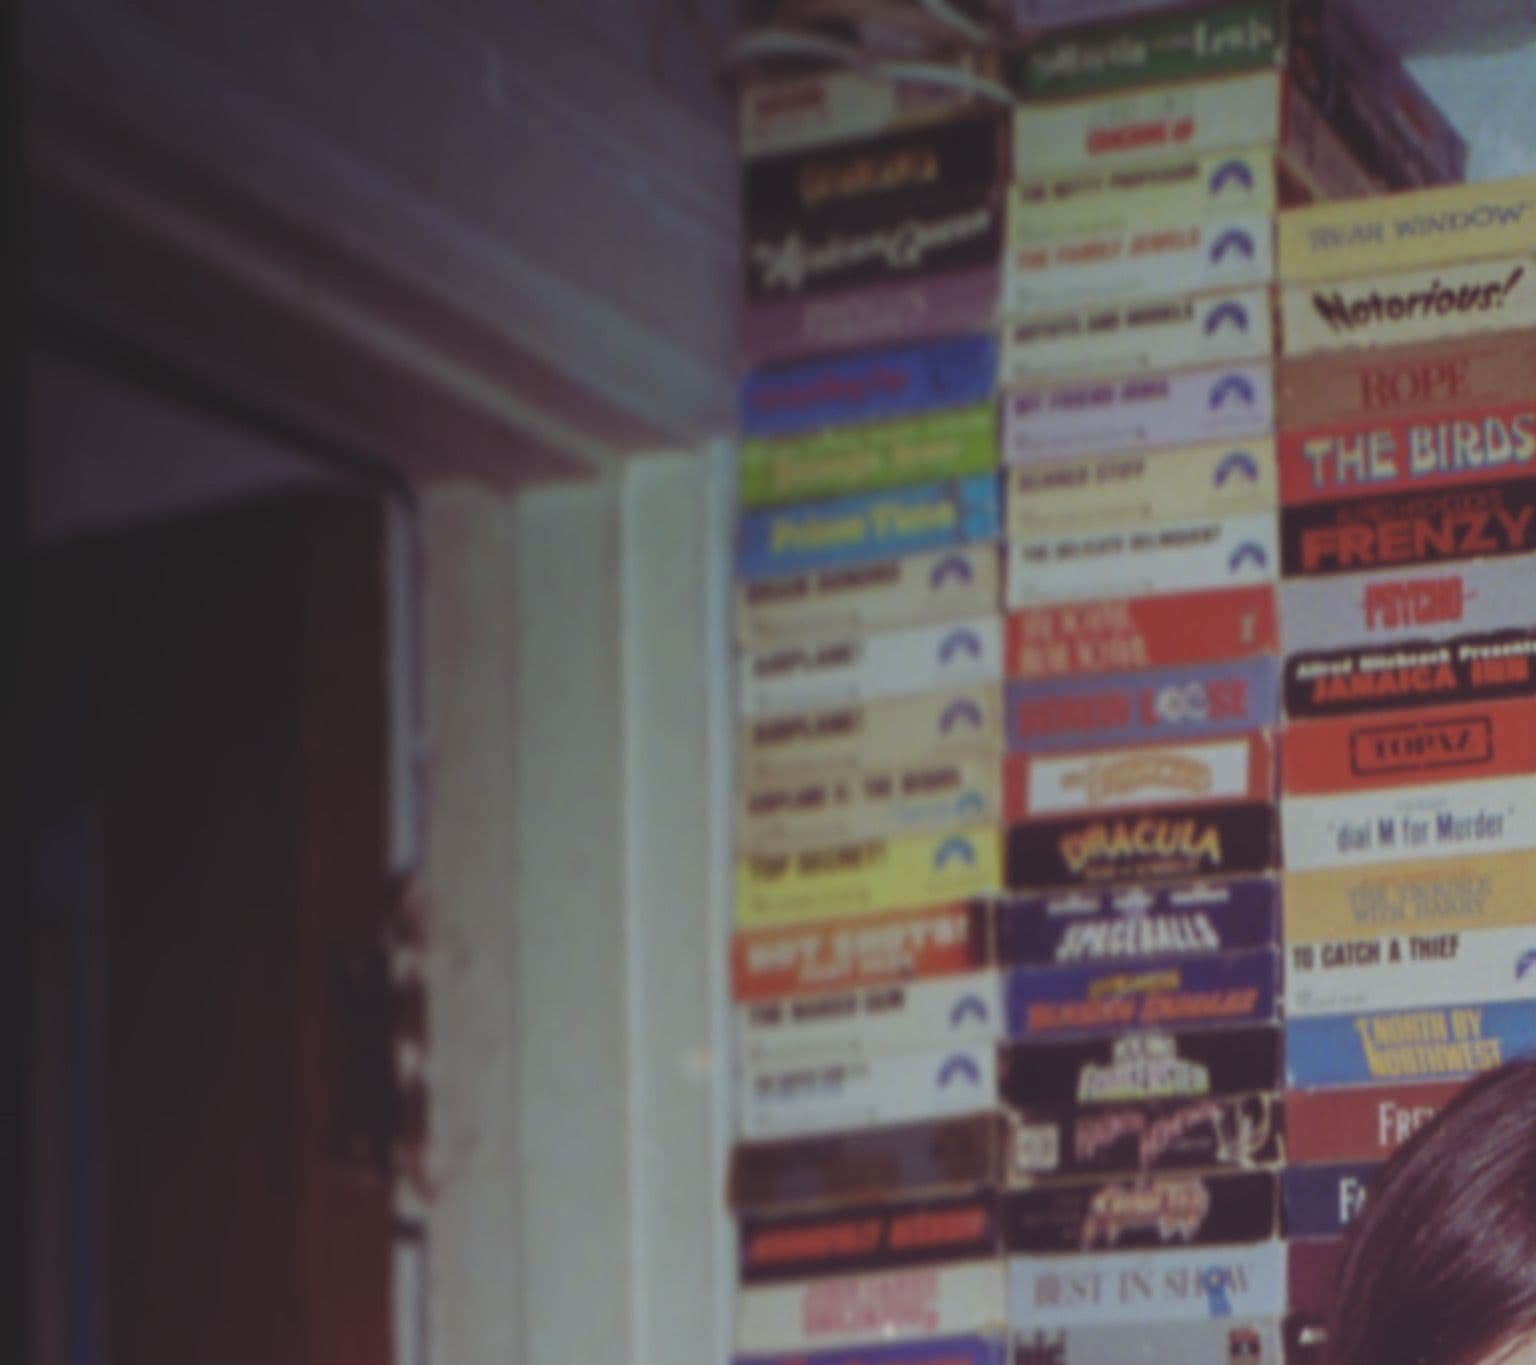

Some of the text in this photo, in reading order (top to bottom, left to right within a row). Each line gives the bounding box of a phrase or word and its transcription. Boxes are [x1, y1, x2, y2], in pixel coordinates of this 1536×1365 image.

[1392, 200, 1536, 241] WINDOW
[1311, 264, 1526, 334] Notorious!
[1357, 356, 1471, 412] ROPE
[1302, 428, 1399, 490] THE
[1311, 662, 1456, 707] JAMAICA
[1367, 729, 1475, 764] TOPAZ
[1377, 819, 1396, 846] M
[1402, 817, 1429, 843] for
[1291, 932, 1460, 971] TO CATCH A THIEF
[1451, 1008, 1482, 1039] BY
[1118, 1266, 1153, 1308] IN
